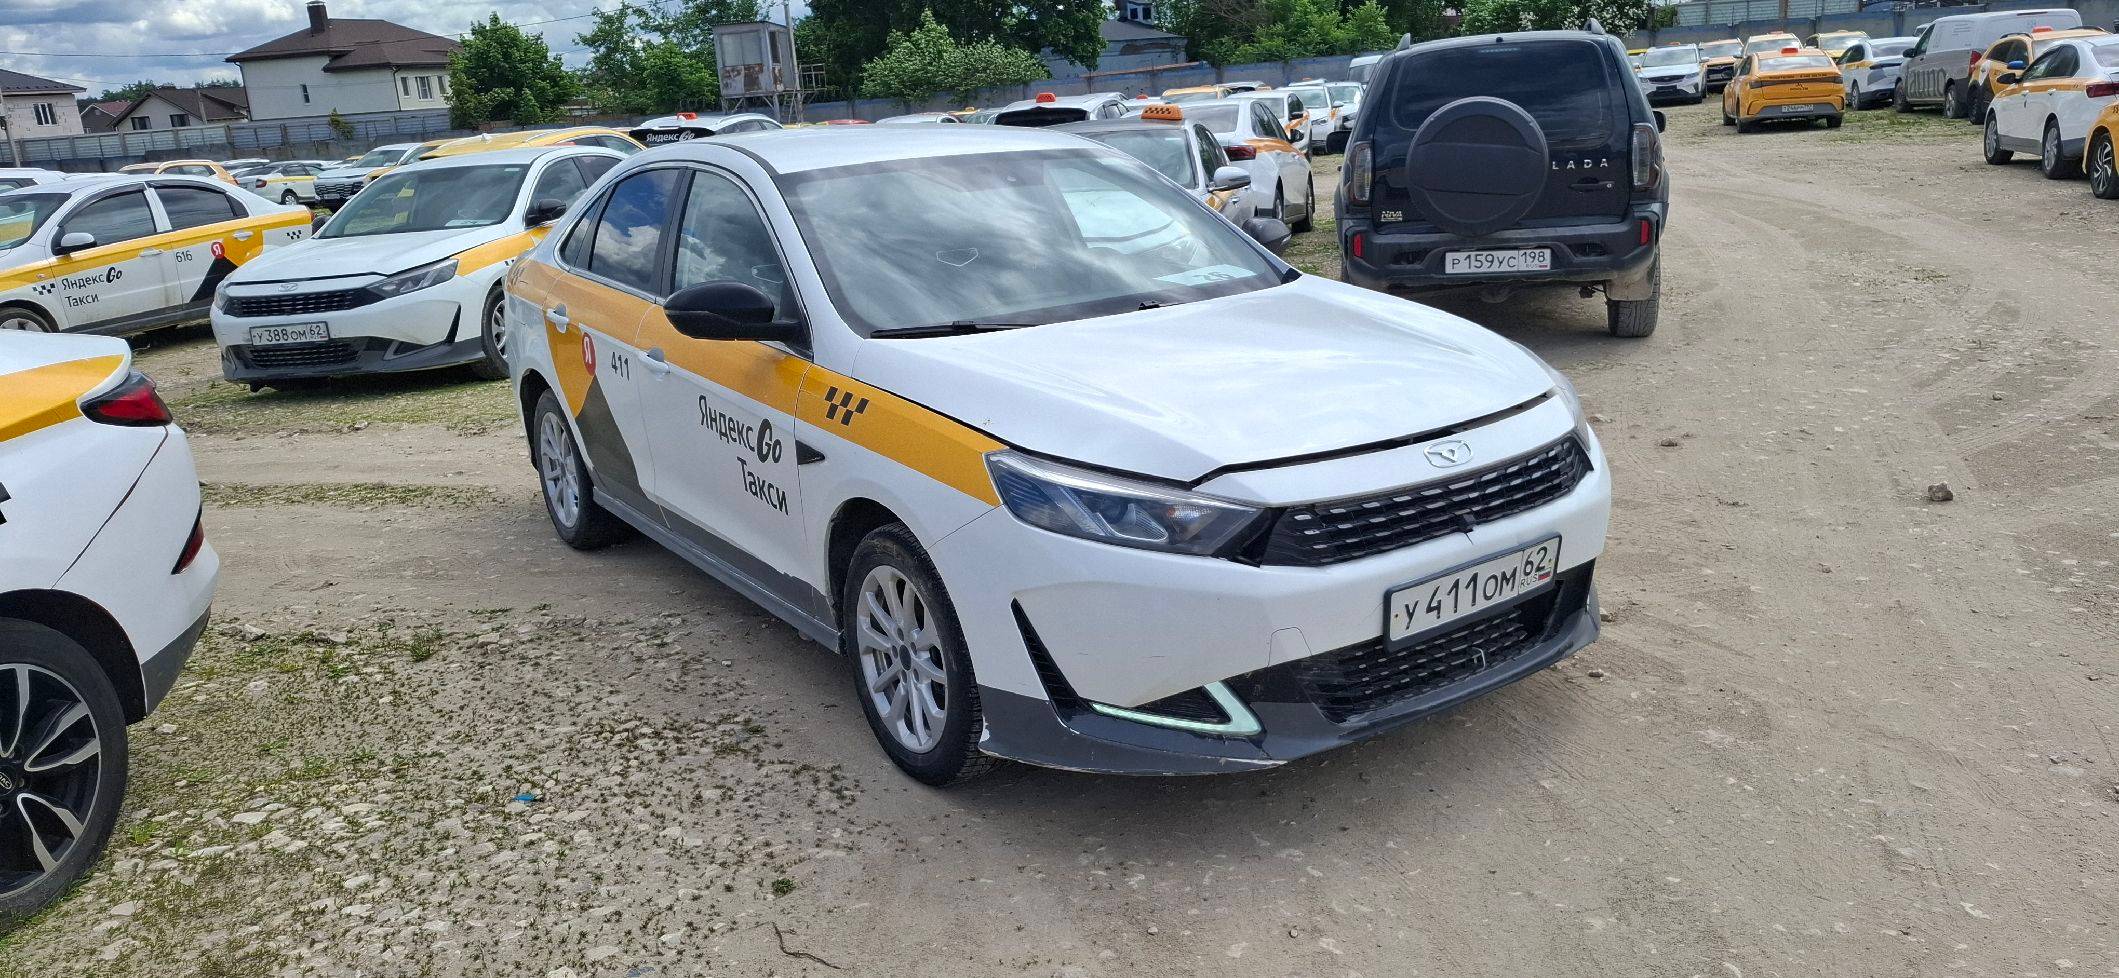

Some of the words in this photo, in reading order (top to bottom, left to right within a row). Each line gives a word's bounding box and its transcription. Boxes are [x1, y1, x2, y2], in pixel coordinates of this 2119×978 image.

[647, 133, 679, 142] Яндекс
[680, 130, 695, 141] Go
[1552, 159, 1608, 170] LADA
[175, 250, 193, 264] 616
[212, 245, 222, 256] Я
[1521, 251, 1546, 264] 198
[61, 272, 105, 291] Яндекс
[105, 266, 123, 284] Go
[65, 293, 99, 308] Такси
[309, 325, 323, 336] 62
[582, 333, 592, 364] Я
[611, 352, 630, 381] 411
[698, 395, 755, 452] Яндекс
[757, 418, 782, 464] Go
[737, 456, 789, 516] Такси
[1405, 566, 1518, 630] У411ОМ
[1523, 546, 1548, 577] 62
[1520, 573, 1538, 588] RUS
